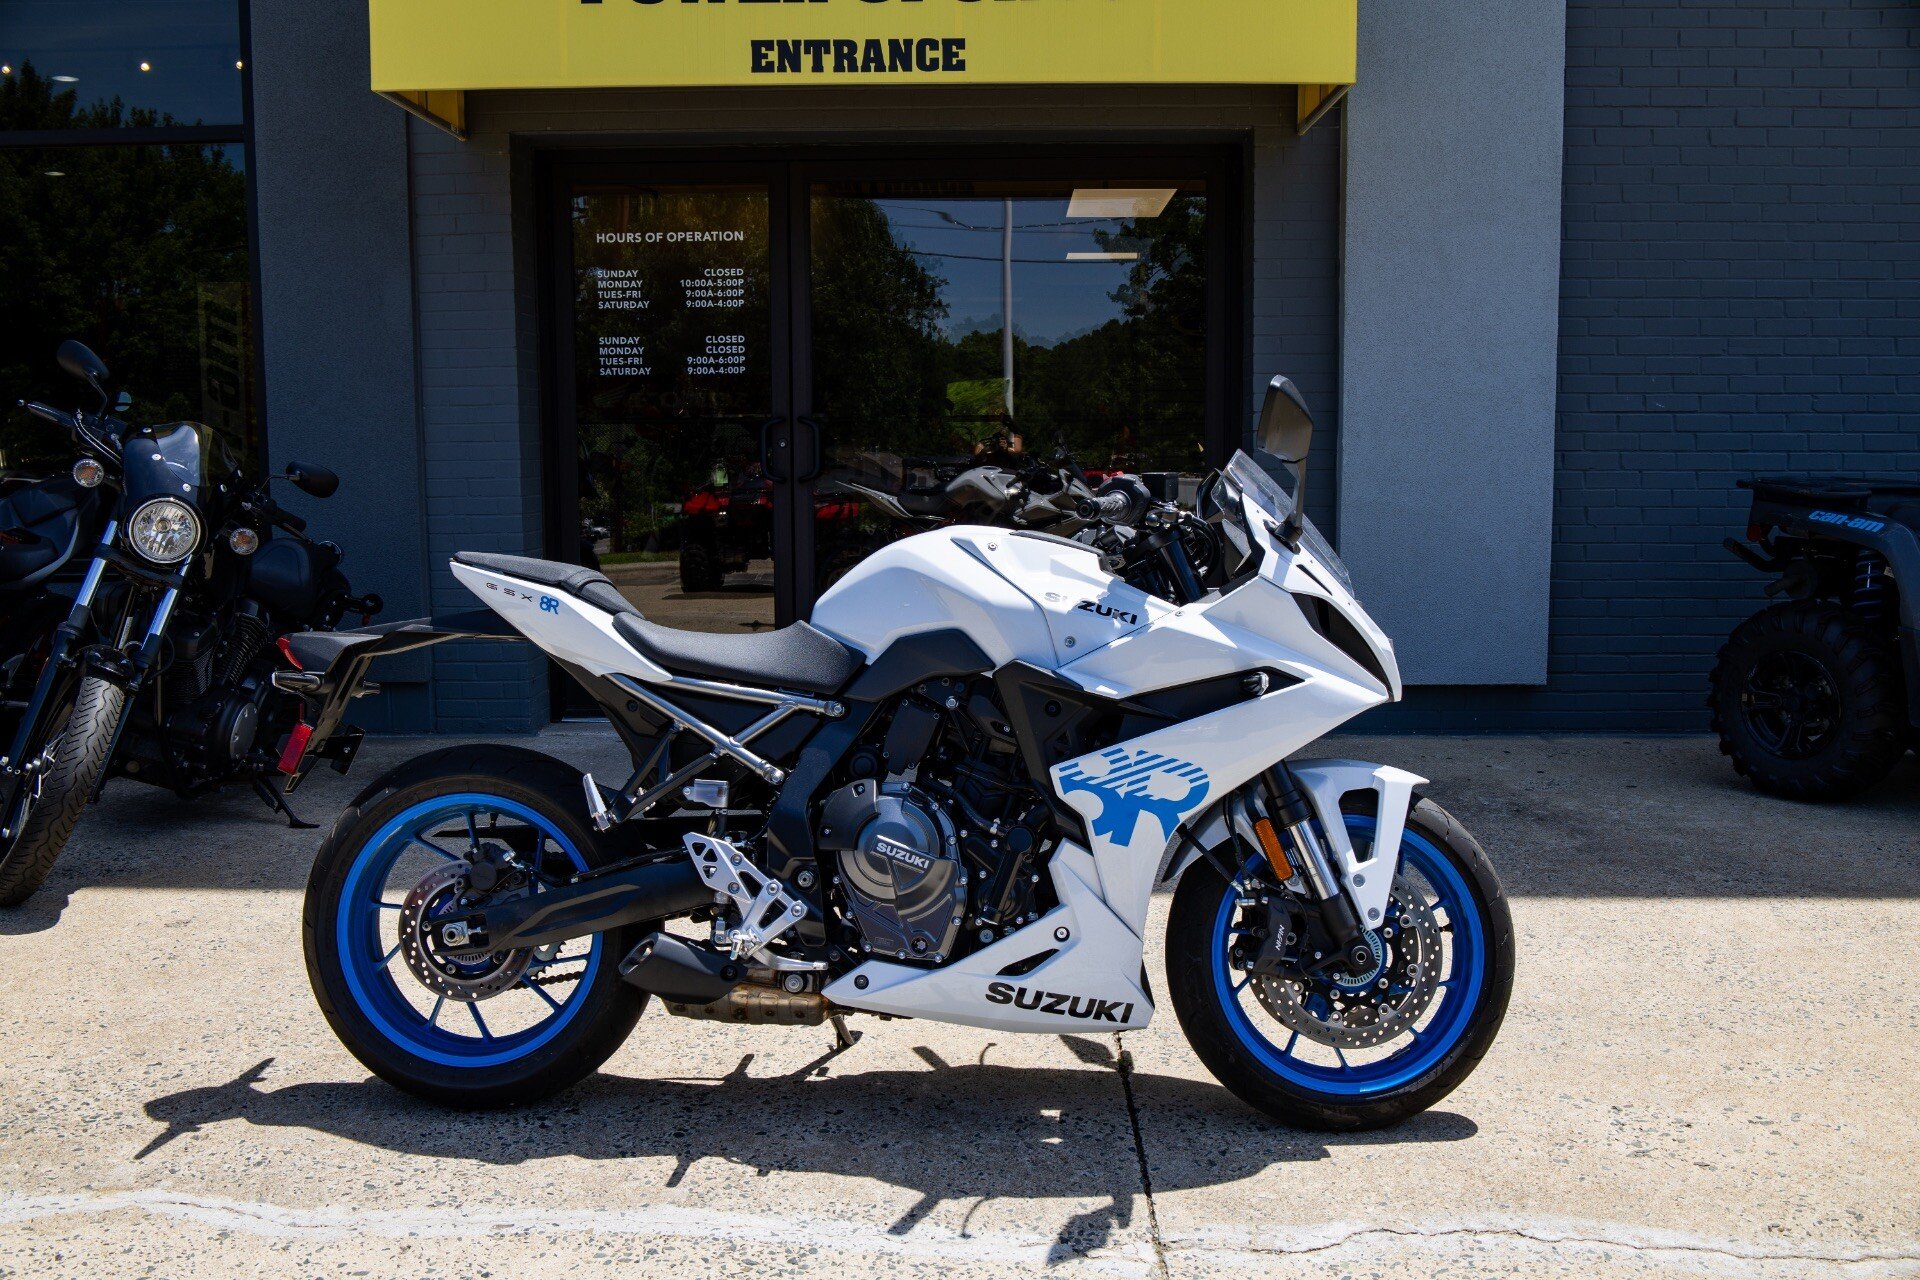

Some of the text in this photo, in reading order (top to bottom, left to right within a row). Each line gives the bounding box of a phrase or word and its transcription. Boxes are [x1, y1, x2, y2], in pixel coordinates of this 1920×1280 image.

[751, 38, 966, 73] ENTRANCE
[596, 230, 745, 244] HOURS OF OPERATION
[597, 267, 744, 279] SUNDAY CLOSED
[597, 278, 745, 289] MONDAY 10:00A-5:00P
[597, 288, 745, 299] TUES-FRI 9:00A-6:00P
[598, 299, 745, 310] SATURDAY 9:00A-4:00P
[598, 335, 746, 345] SUNDAY CLOSED
[599, 345, 746, 356] MONDAY CLOSED
[599, 355, 746, 366] TUES-FRI 9:00A-6:00P
[599, 365, 746, 376] SATURDAY 9:00A-4:00P
[1809, 511, 1884, 532] can-am
[539, 595, 560, 615] 8R
[876, 842, 930, 869] SUZUKI
[985, 981, 1134, 1024] SUZUKI
